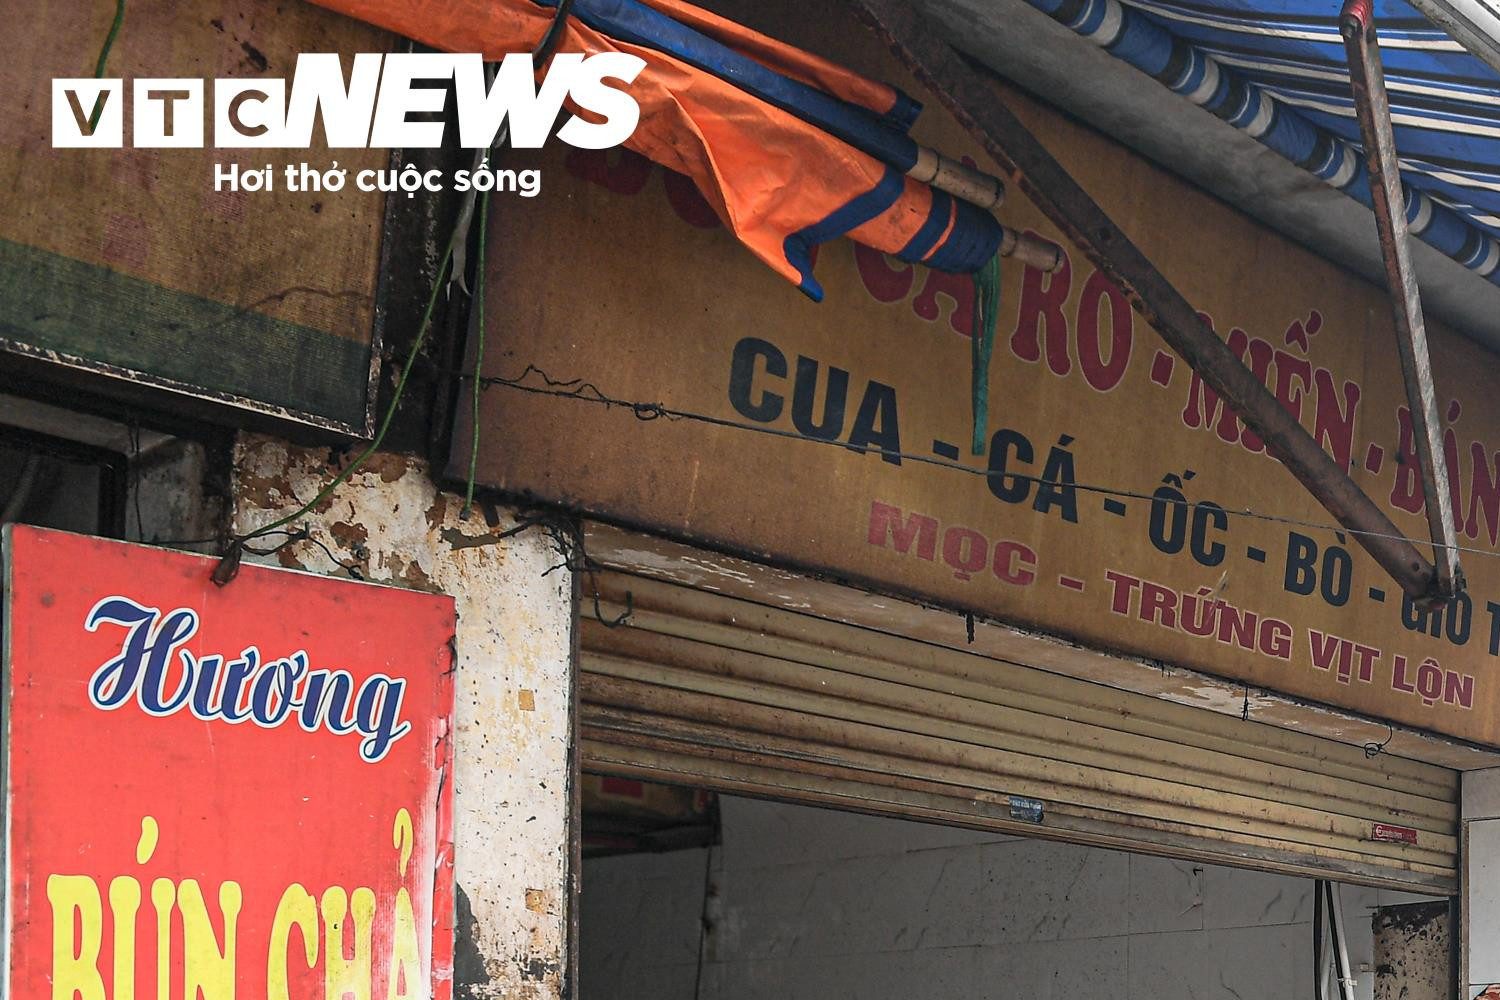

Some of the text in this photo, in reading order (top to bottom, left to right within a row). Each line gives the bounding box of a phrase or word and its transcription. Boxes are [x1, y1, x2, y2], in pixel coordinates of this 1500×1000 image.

[727, 336, 903, 467] CUA
[986, 428, 1079, 525] CÁ
[1148, 469, 1229, 568] ỐC
[1283, 529, 1353, 607] BÒ
[86, 596, 411, 763] Hương
[867, 500, 1038, 588] MỌC
[1104, 569, 1294, 661] TRỨNG
[1307, 628, 1382, 685] VỊT
[1391, 654, 1475, 710] LỘN
